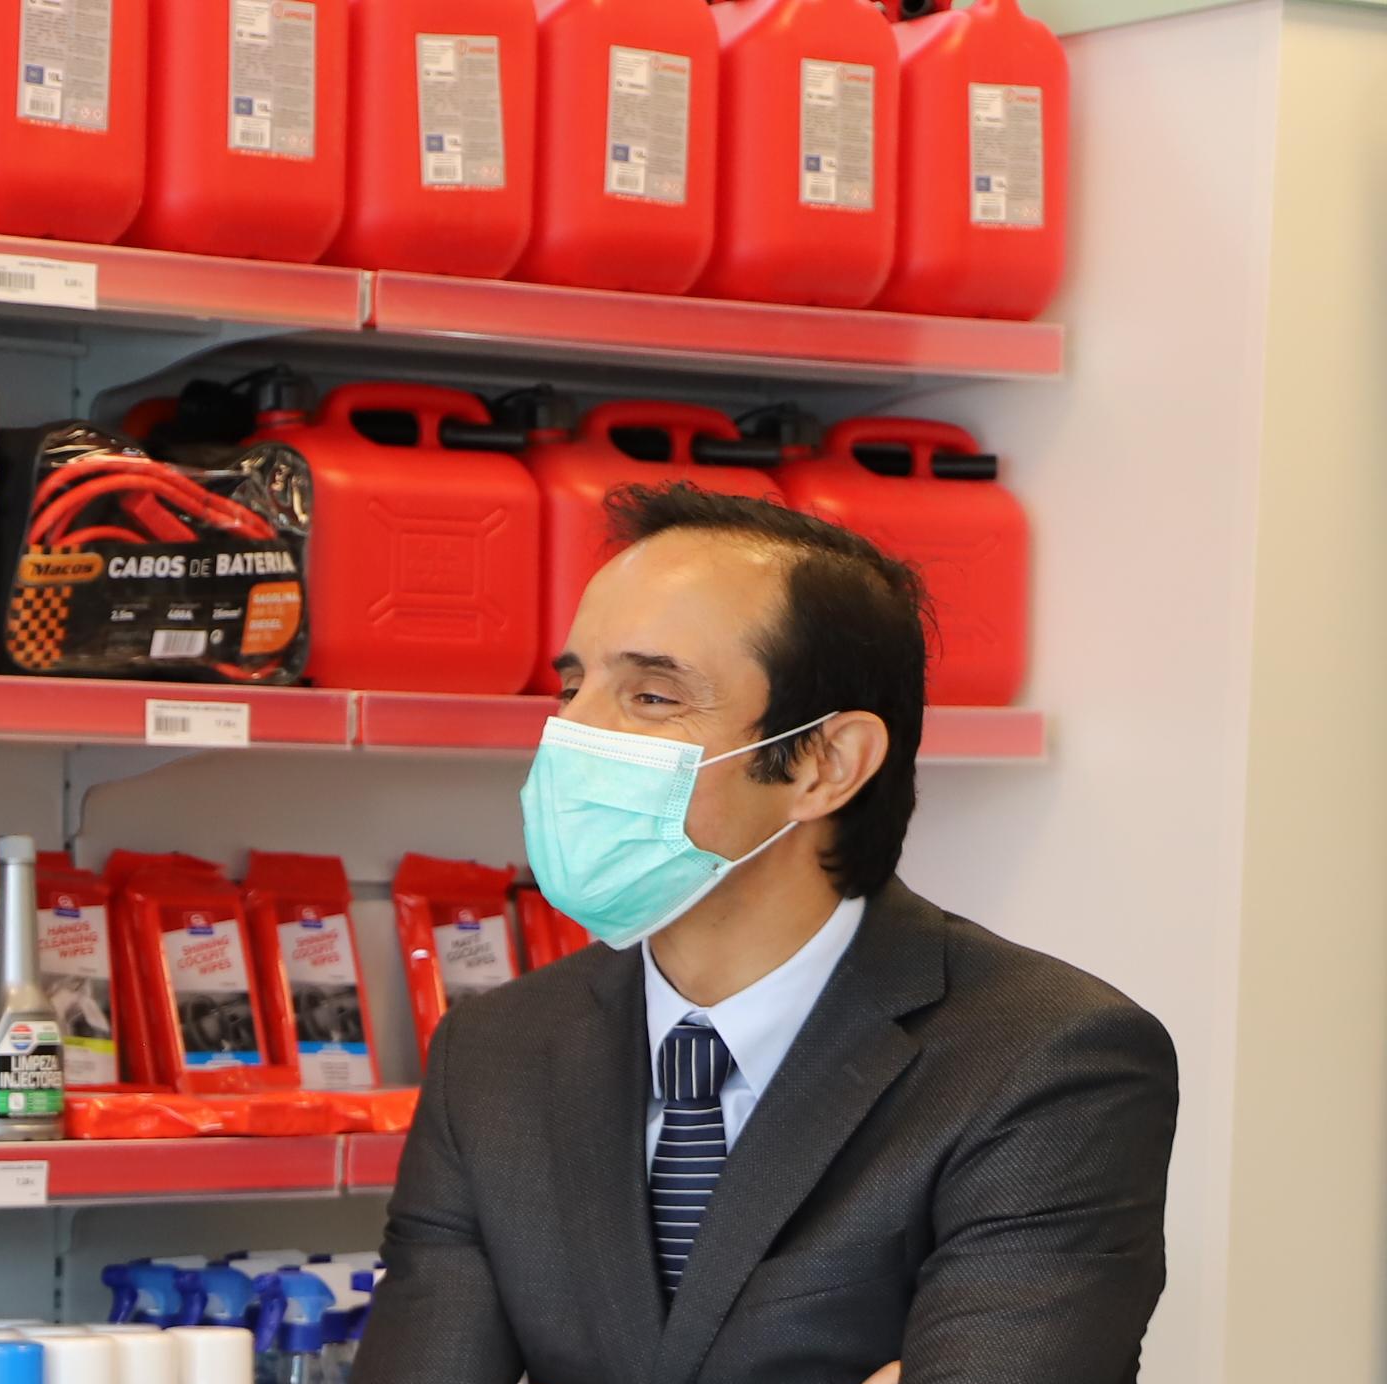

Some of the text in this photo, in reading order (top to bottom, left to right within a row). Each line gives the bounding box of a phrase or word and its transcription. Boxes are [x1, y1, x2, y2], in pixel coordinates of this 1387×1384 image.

[31, 562, 93, 576] Macos
[109, 552, 296, 578] CABOS DE BATERIA
[11, 1055, 58, 1071] LIMPEZA
